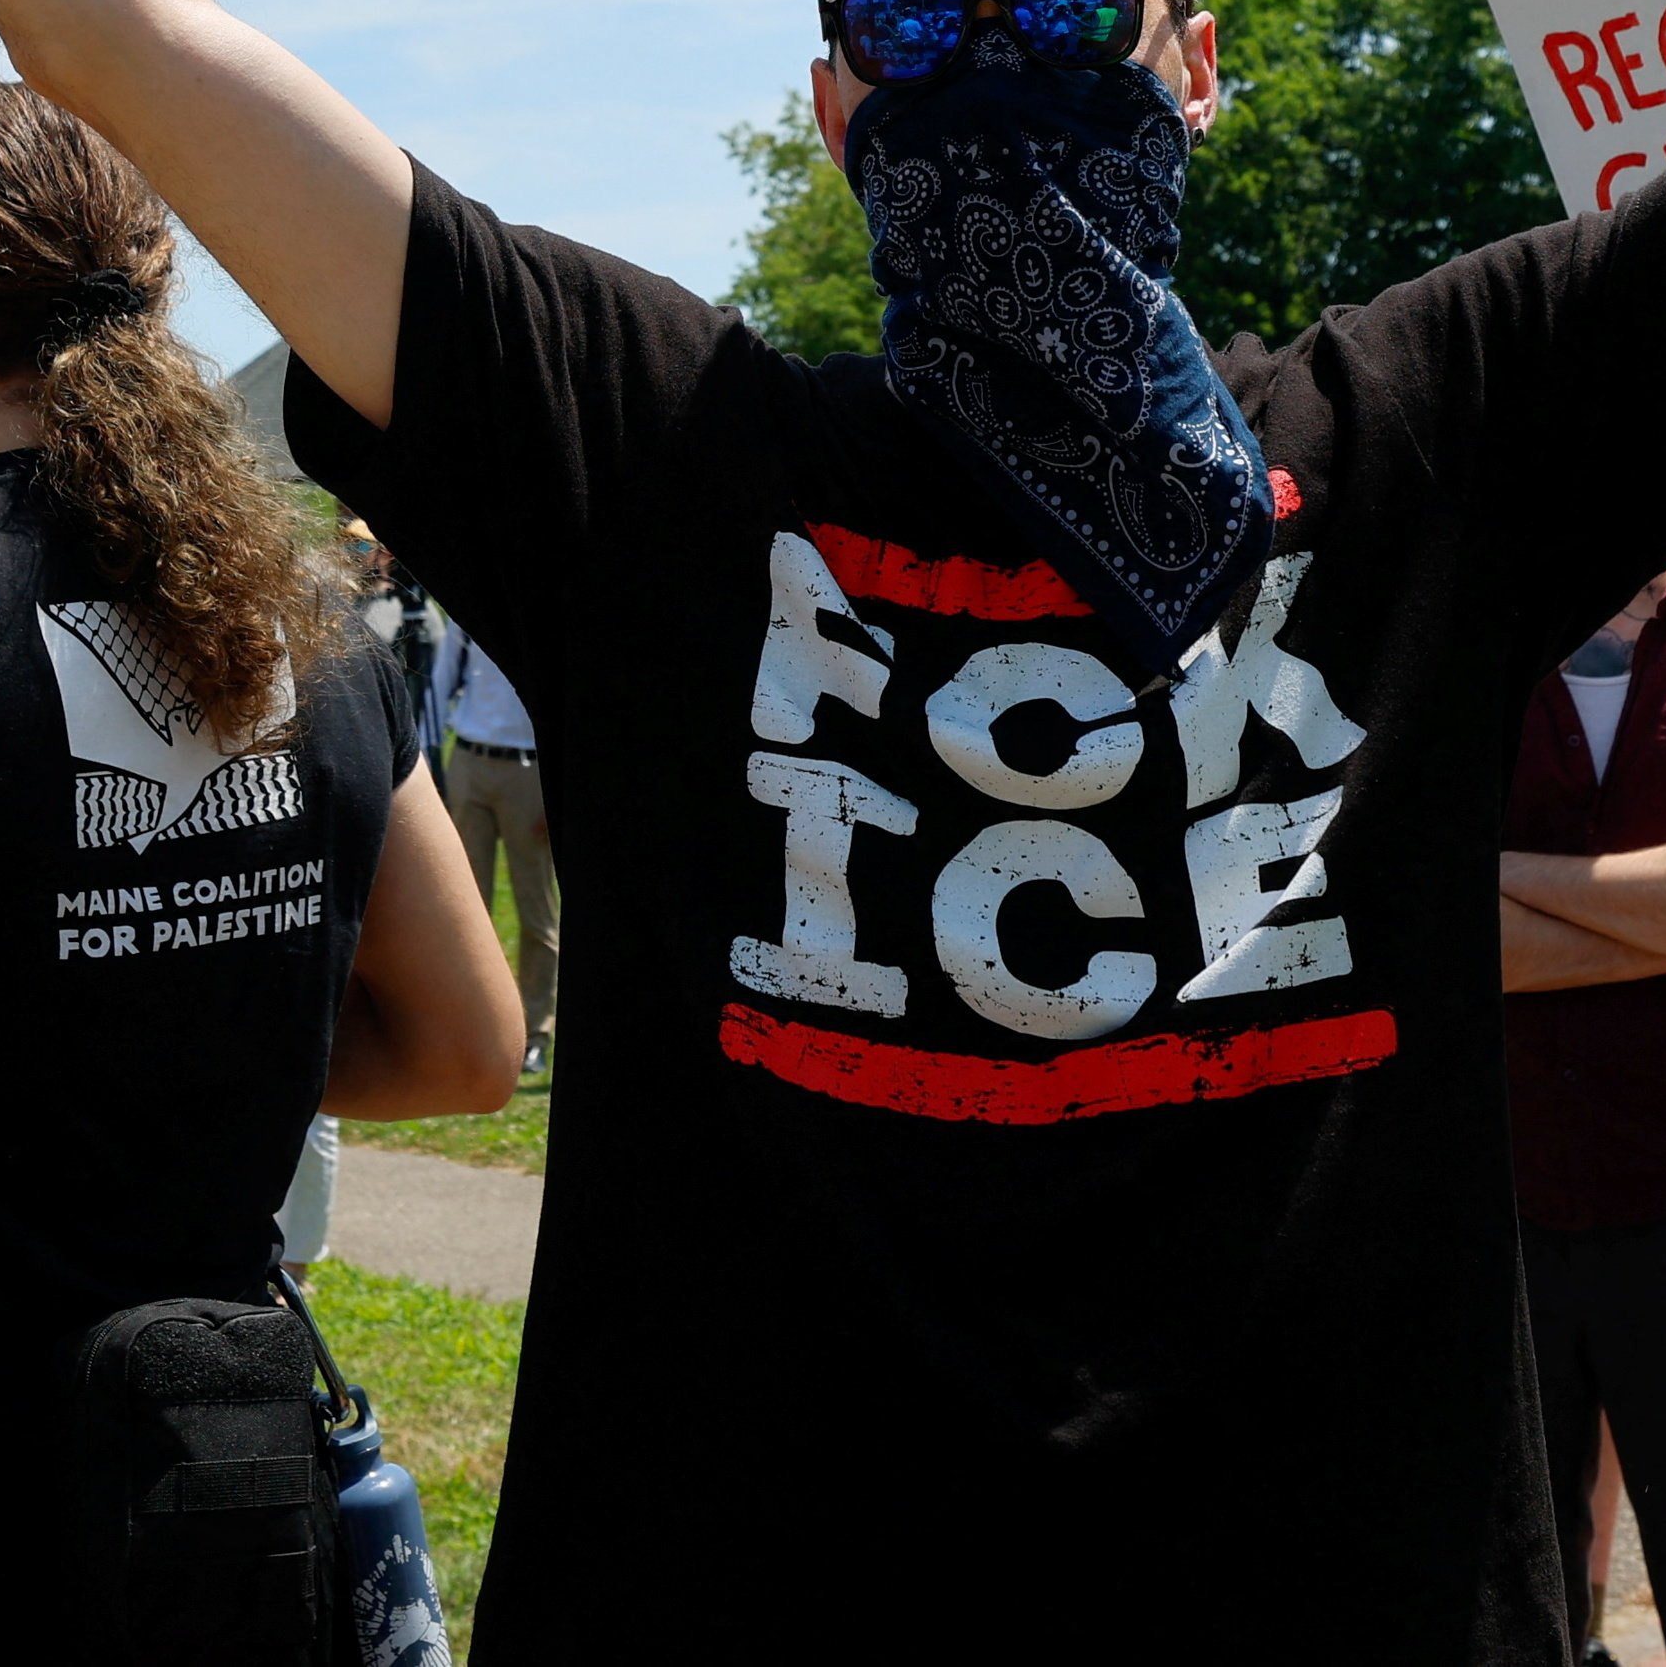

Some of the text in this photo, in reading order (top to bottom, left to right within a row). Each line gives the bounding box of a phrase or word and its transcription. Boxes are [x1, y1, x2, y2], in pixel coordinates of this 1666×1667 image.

[751, 531, 1368, 810] FCK
[57, 859, 324, 918] MAINE COALITION
[59, 894, 322, 960] FOR PALESTINE
[729, 751, 1353, 1040] ICE
